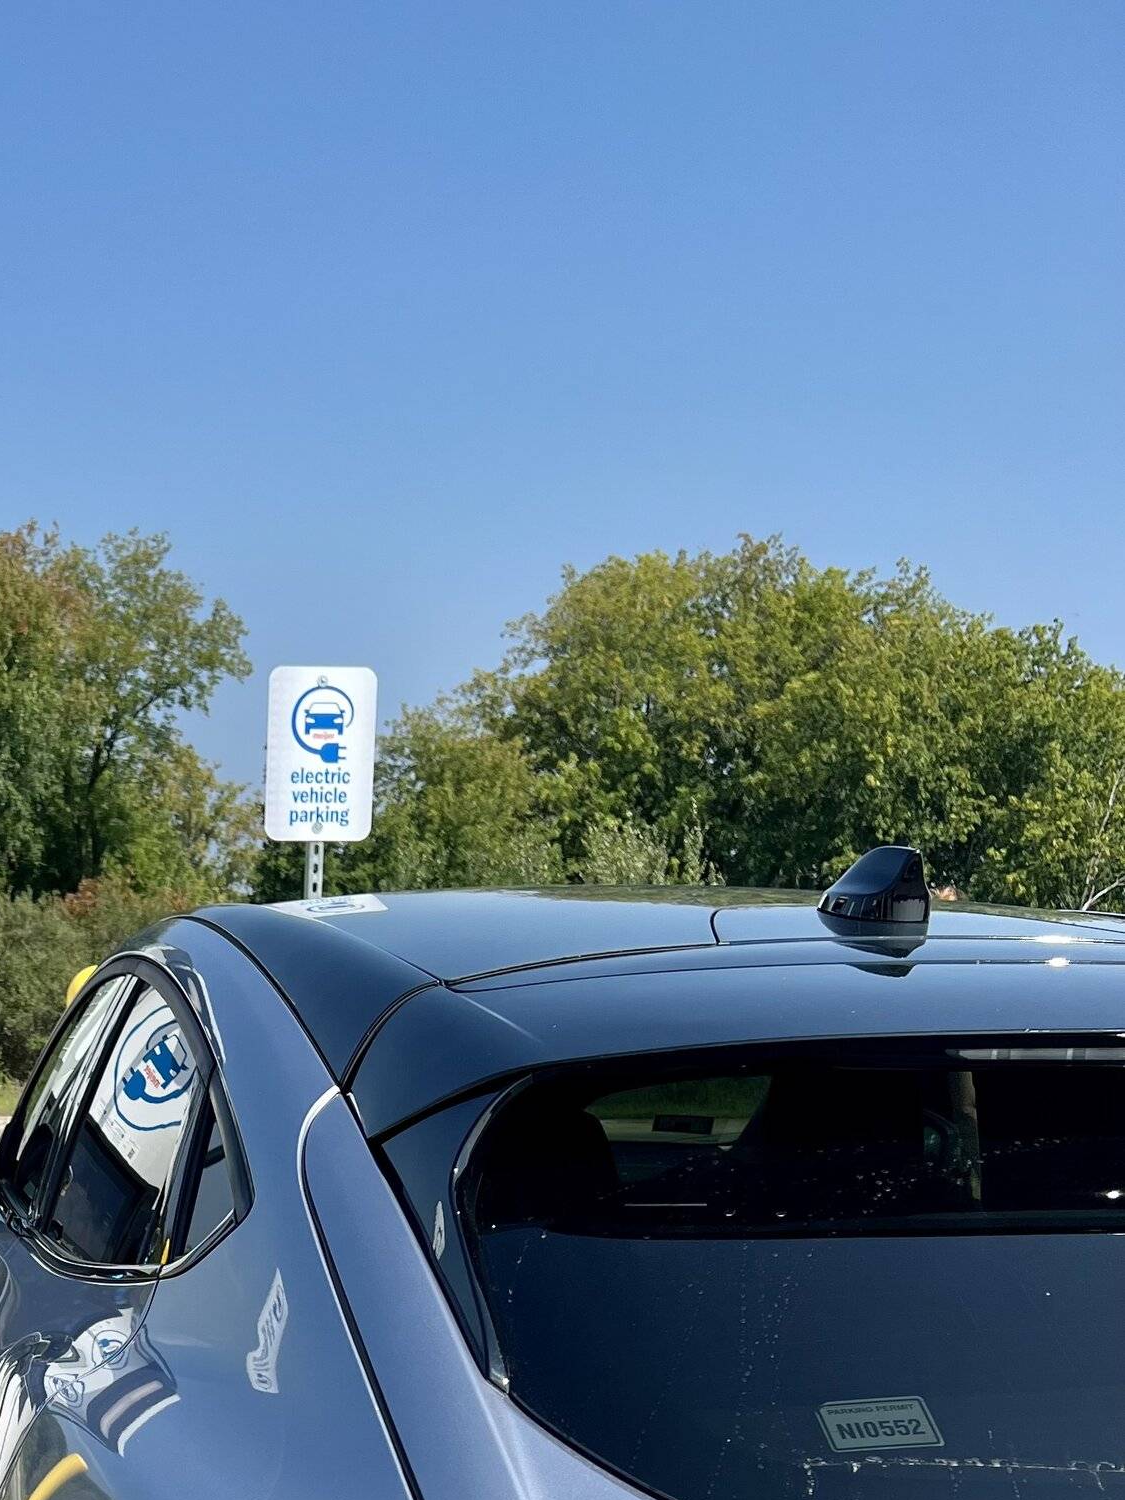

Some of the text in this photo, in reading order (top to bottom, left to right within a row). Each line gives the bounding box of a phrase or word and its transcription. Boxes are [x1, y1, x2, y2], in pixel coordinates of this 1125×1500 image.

[291, 767, 350, 784] electric
[292, 786, 347, 803] vehicle
[289, 806, 350, 826] parking
[827, 1403, 914, 1415] PARKING PERMIT
